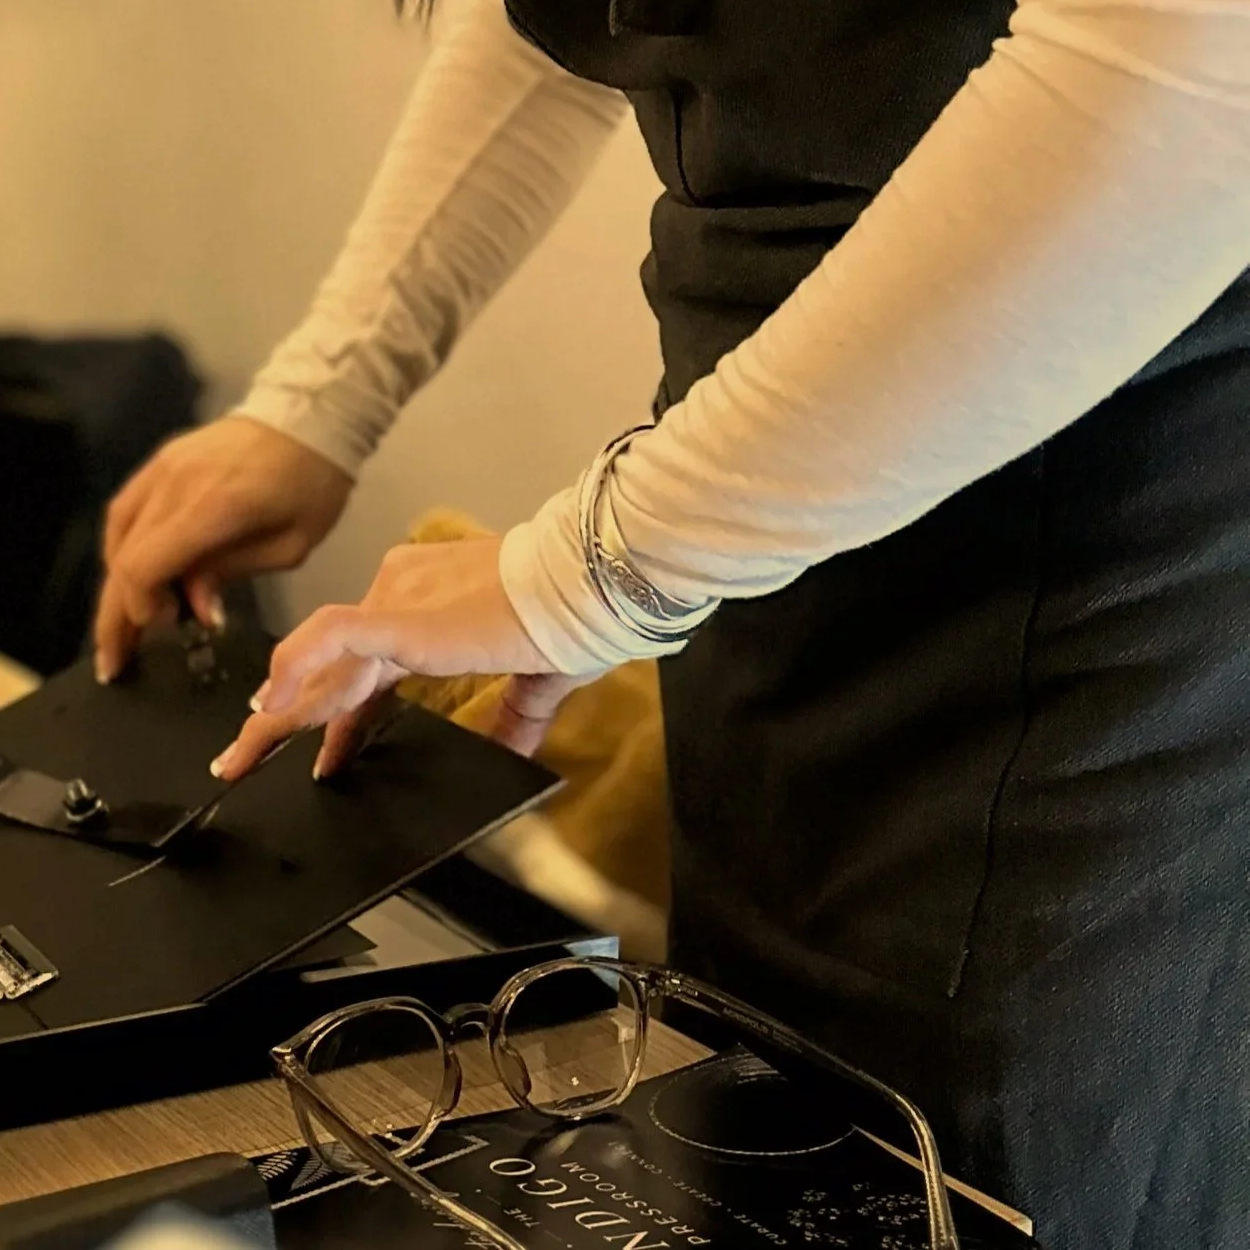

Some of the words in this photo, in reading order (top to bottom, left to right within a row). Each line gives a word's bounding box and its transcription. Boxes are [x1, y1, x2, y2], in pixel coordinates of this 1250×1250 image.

[502, 1207, 540, 1228] THE
[560, 1161, 712, 1246] PRESSROOM
[733, 1213, 788, 1245] CURATE
